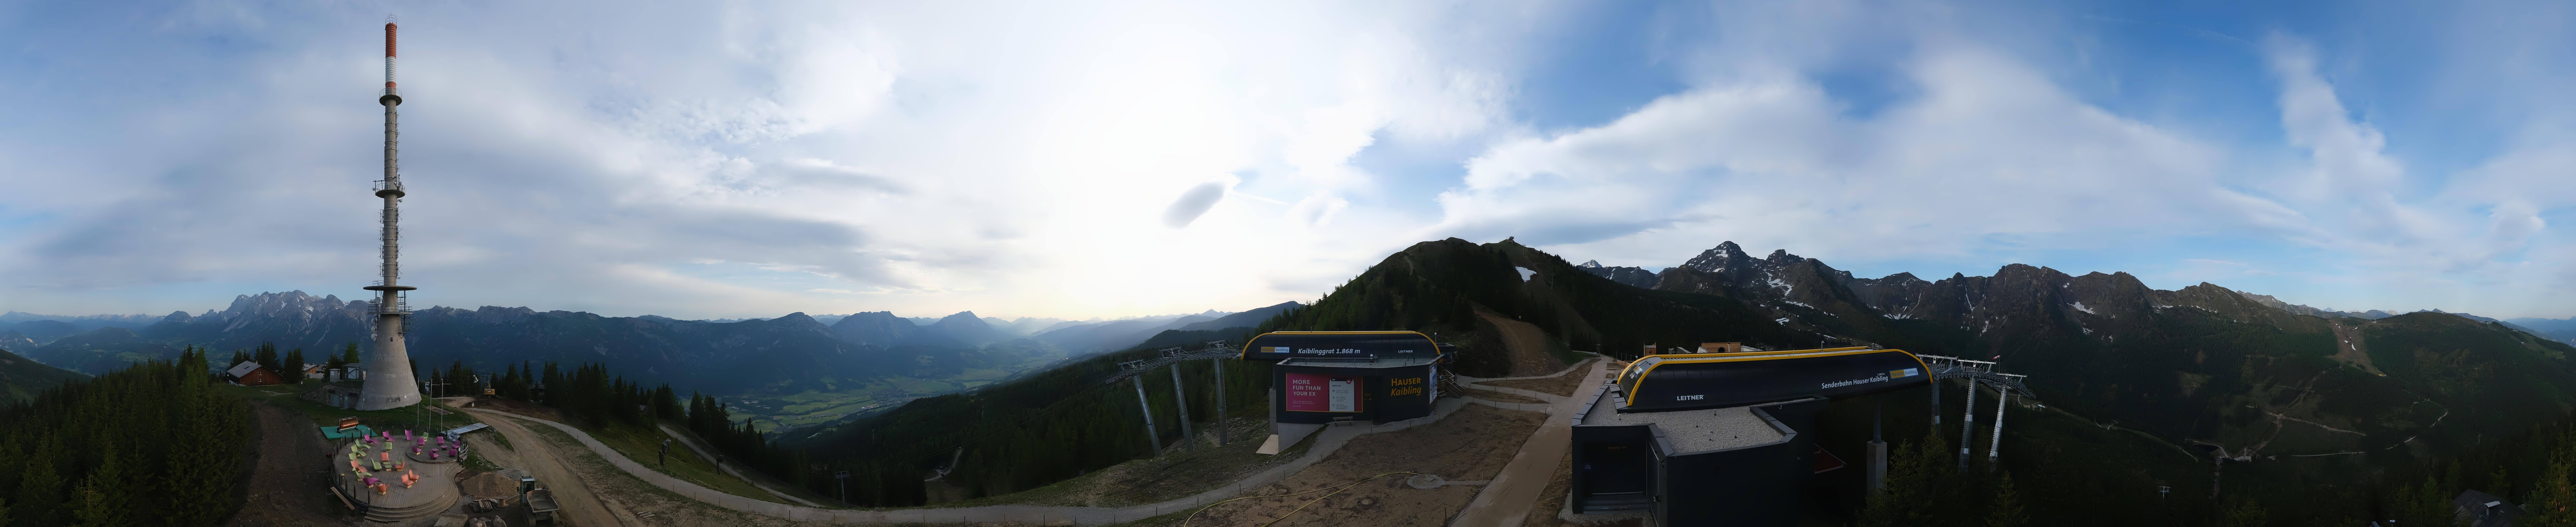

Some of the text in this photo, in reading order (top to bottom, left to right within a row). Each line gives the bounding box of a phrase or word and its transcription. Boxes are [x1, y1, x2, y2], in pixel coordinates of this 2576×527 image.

[1392, 378, 1421, 386] HAUSER
[1822, 380, 1852, 389] Senderbahn
[1391, 386, 1421, 396] Kaibling
